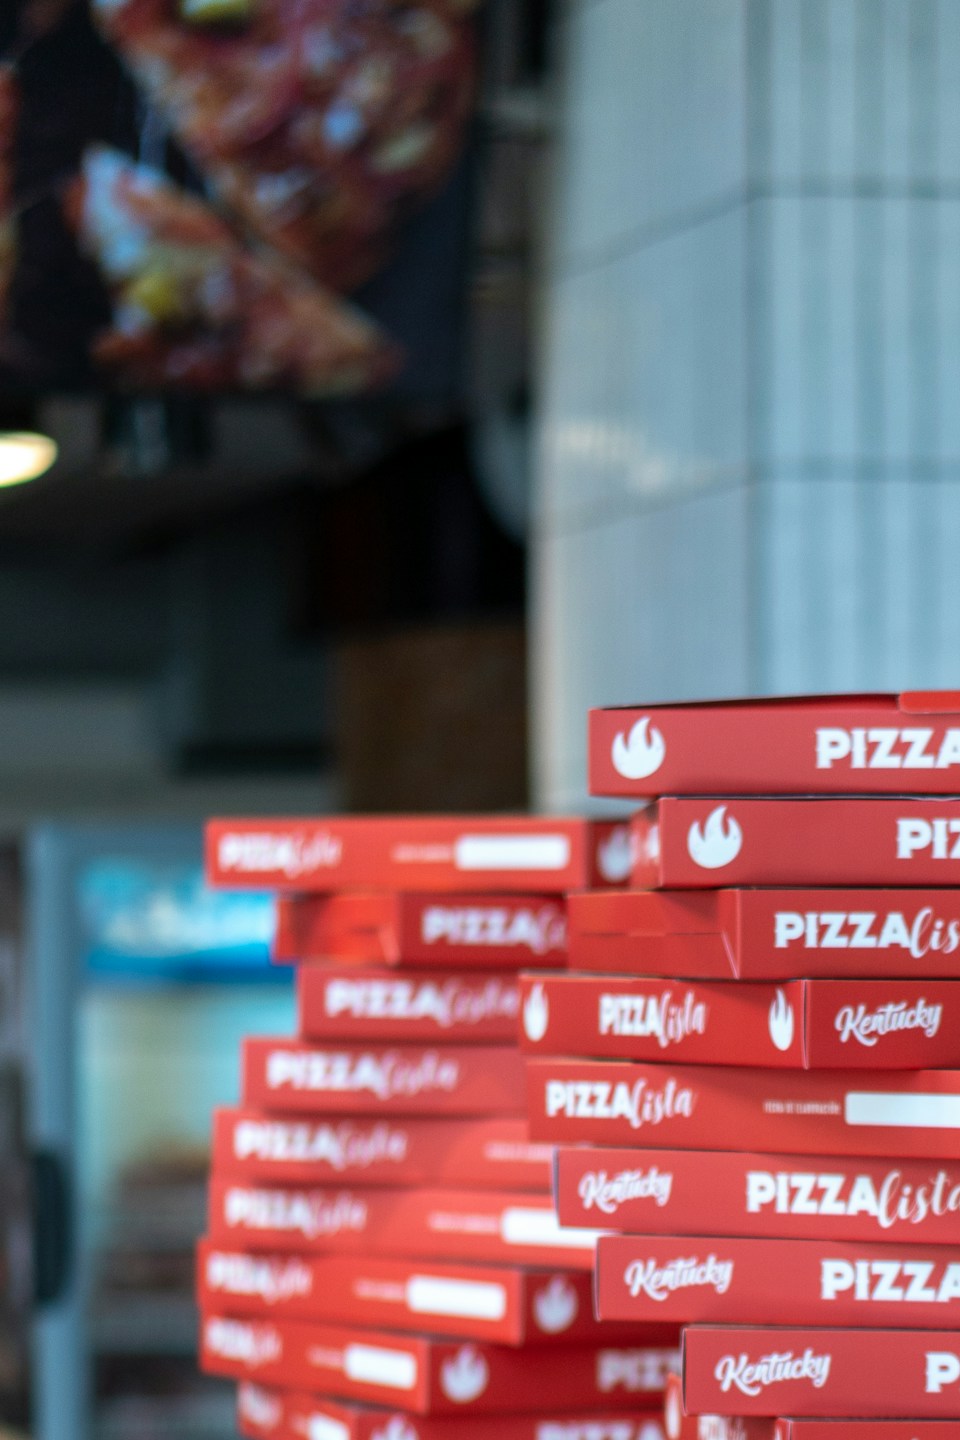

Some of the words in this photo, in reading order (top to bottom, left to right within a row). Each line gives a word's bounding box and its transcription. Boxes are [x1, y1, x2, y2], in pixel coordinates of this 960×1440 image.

[834, 998, 942, 1046] Kentucky
[578, 1167, 673, 1213] Kentucky
[624, 1254, 733, 1300] Kentucky
[715, 1349, 831, 1396] Kentucky
